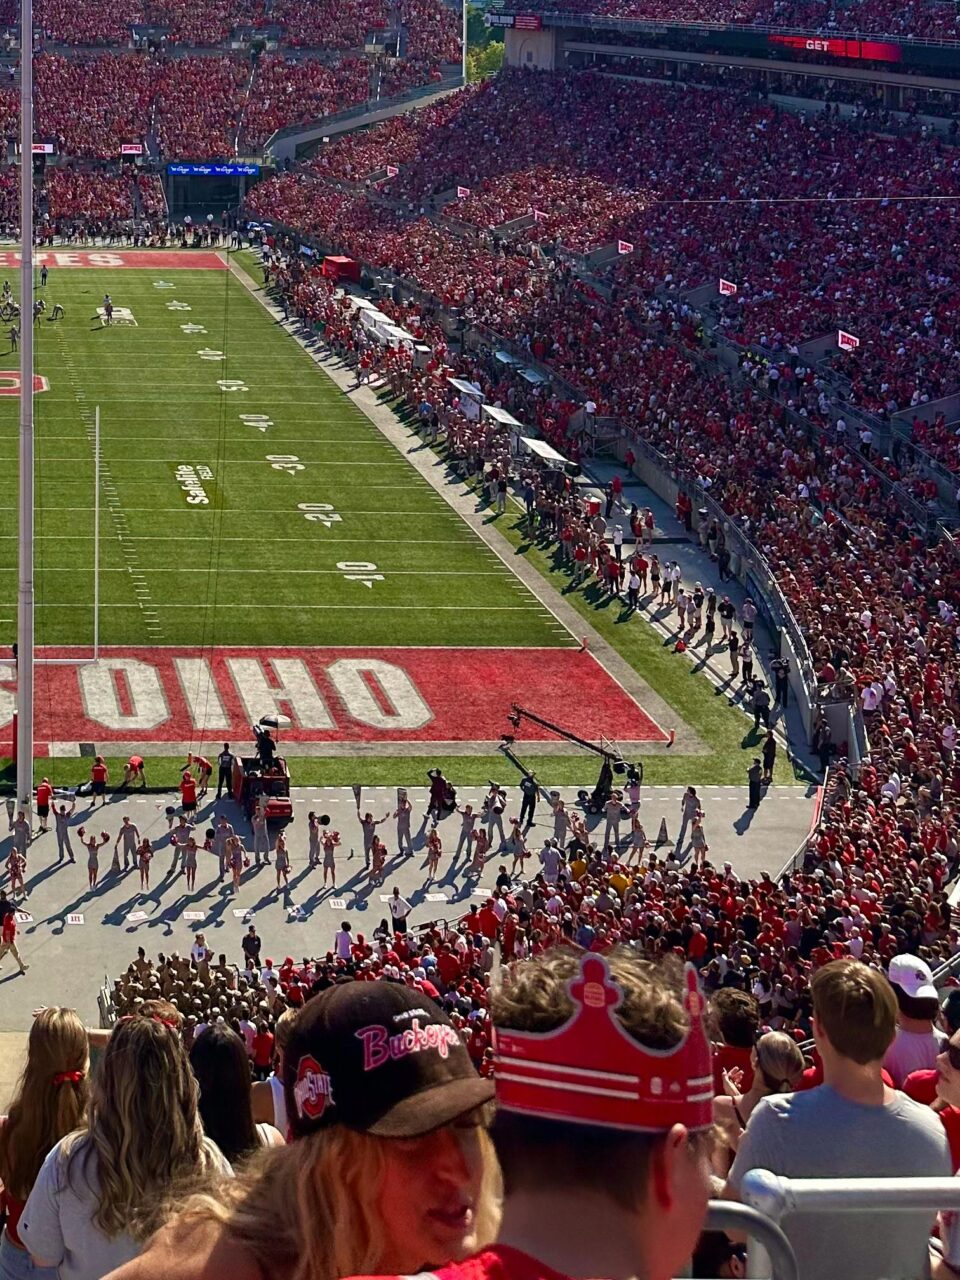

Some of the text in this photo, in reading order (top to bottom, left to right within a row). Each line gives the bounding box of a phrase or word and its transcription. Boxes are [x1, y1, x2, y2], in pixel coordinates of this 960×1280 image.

[805, 39, 829, 51] GET
[216, 379, 249, 391] 50
[239, 414, 274, 426] 40
[265, 455, 306, 470] 30
[195, 465, 215, 480] FIELD
[175, 464, 209, 505] Safelite
[297, 502, 343, 521] 20
[336, 561, 385, 580] 10
[78, 656, 437, 730] OHIO
